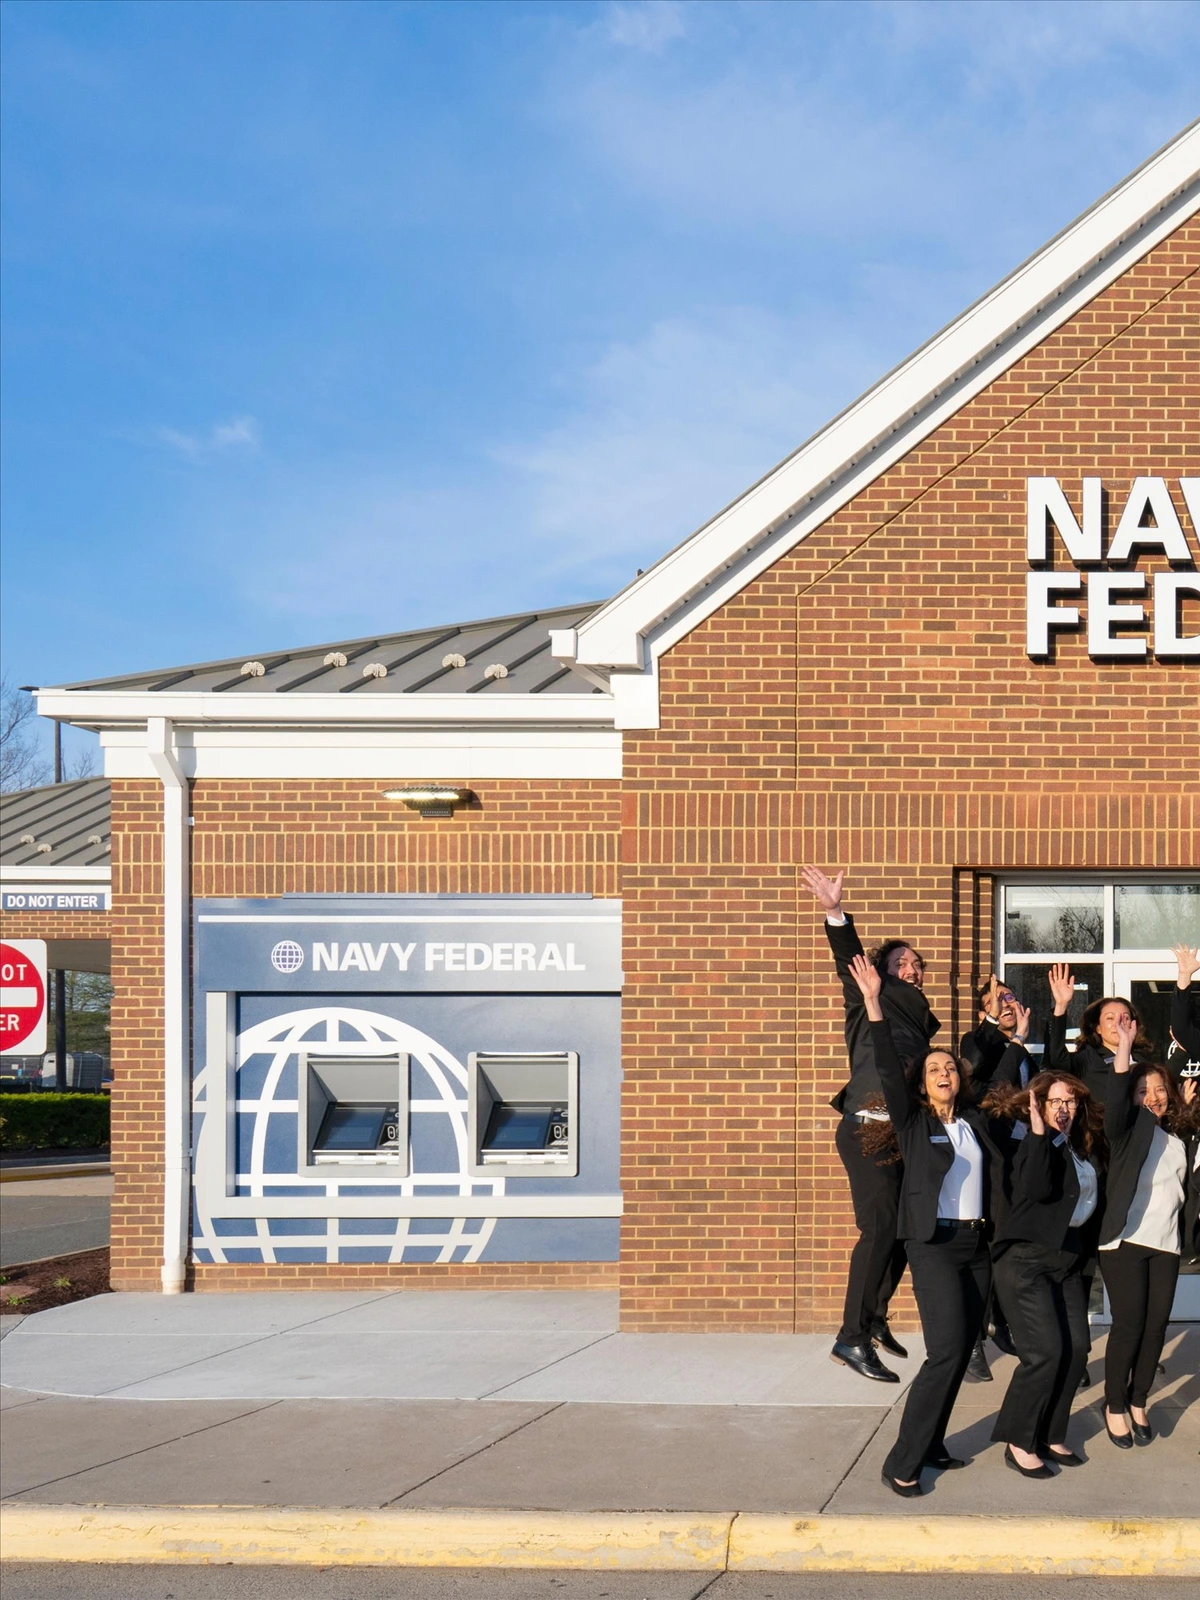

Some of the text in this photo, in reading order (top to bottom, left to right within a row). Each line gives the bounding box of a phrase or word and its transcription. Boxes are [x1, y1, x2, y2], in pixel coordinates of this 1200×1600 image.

[7, 895, 98, 908] DO NOT ENTER
[312, 942, 586, 971] NAVY FEDERAL
